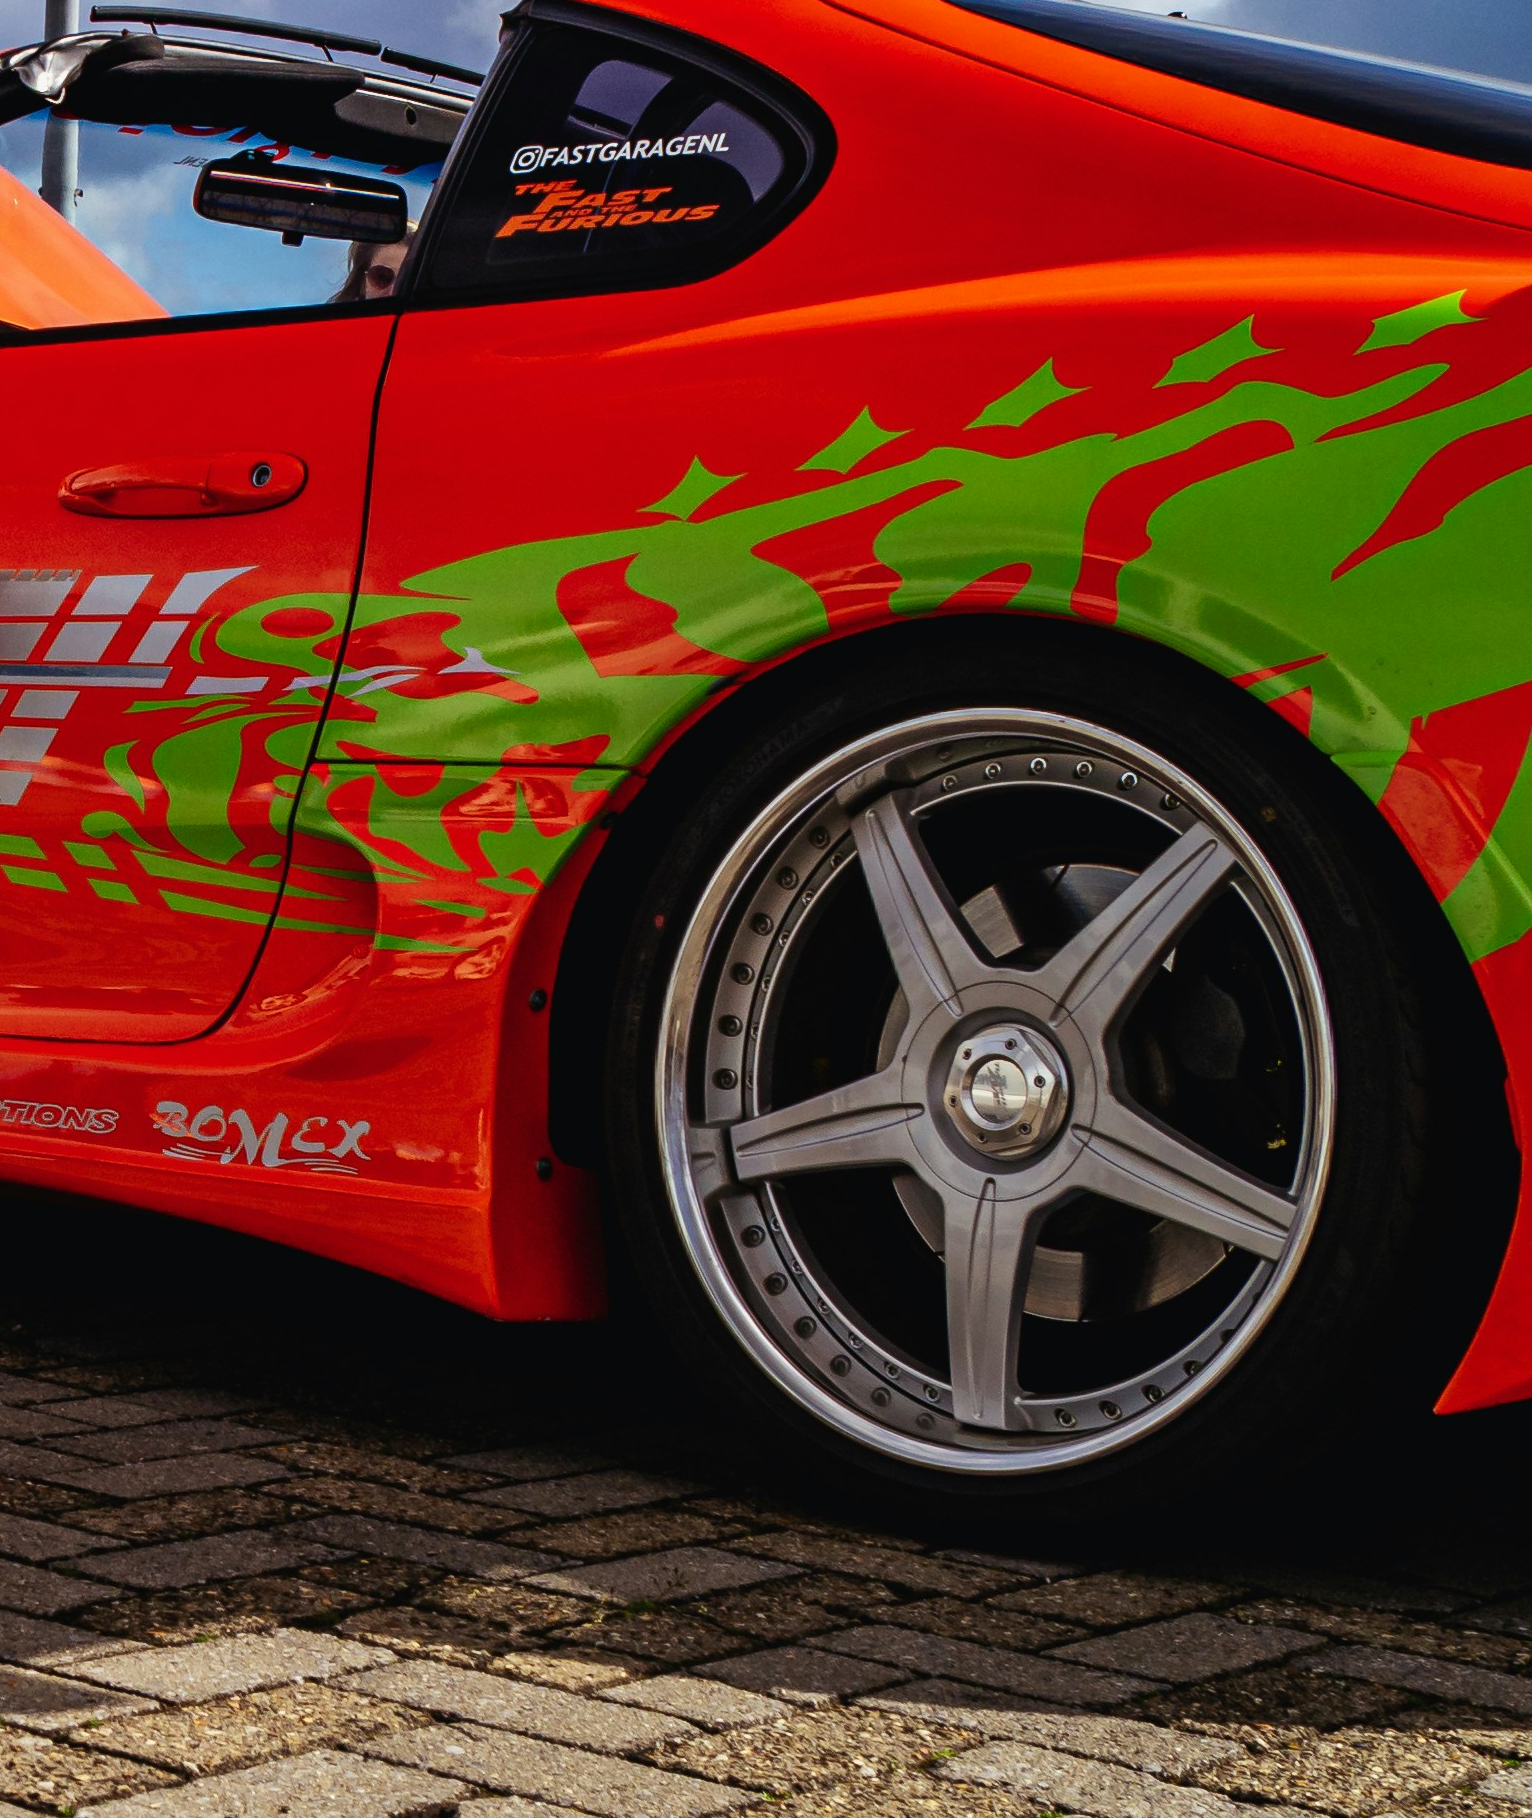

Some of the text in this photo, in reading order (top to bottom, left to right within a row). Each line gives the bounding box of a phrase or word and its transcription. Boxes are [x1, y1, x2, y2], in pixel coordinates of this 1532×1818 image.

[540, 132, 729, 167] FASTGARAGENL
[516, 180, 578, 195] THE
[532, 186, 673, 214] FAST
[495, 205, 720, 238] FURIOUS
[549, 203, 639, 218] AND THE
[153, 1100, 372, 1168] BOMEX
